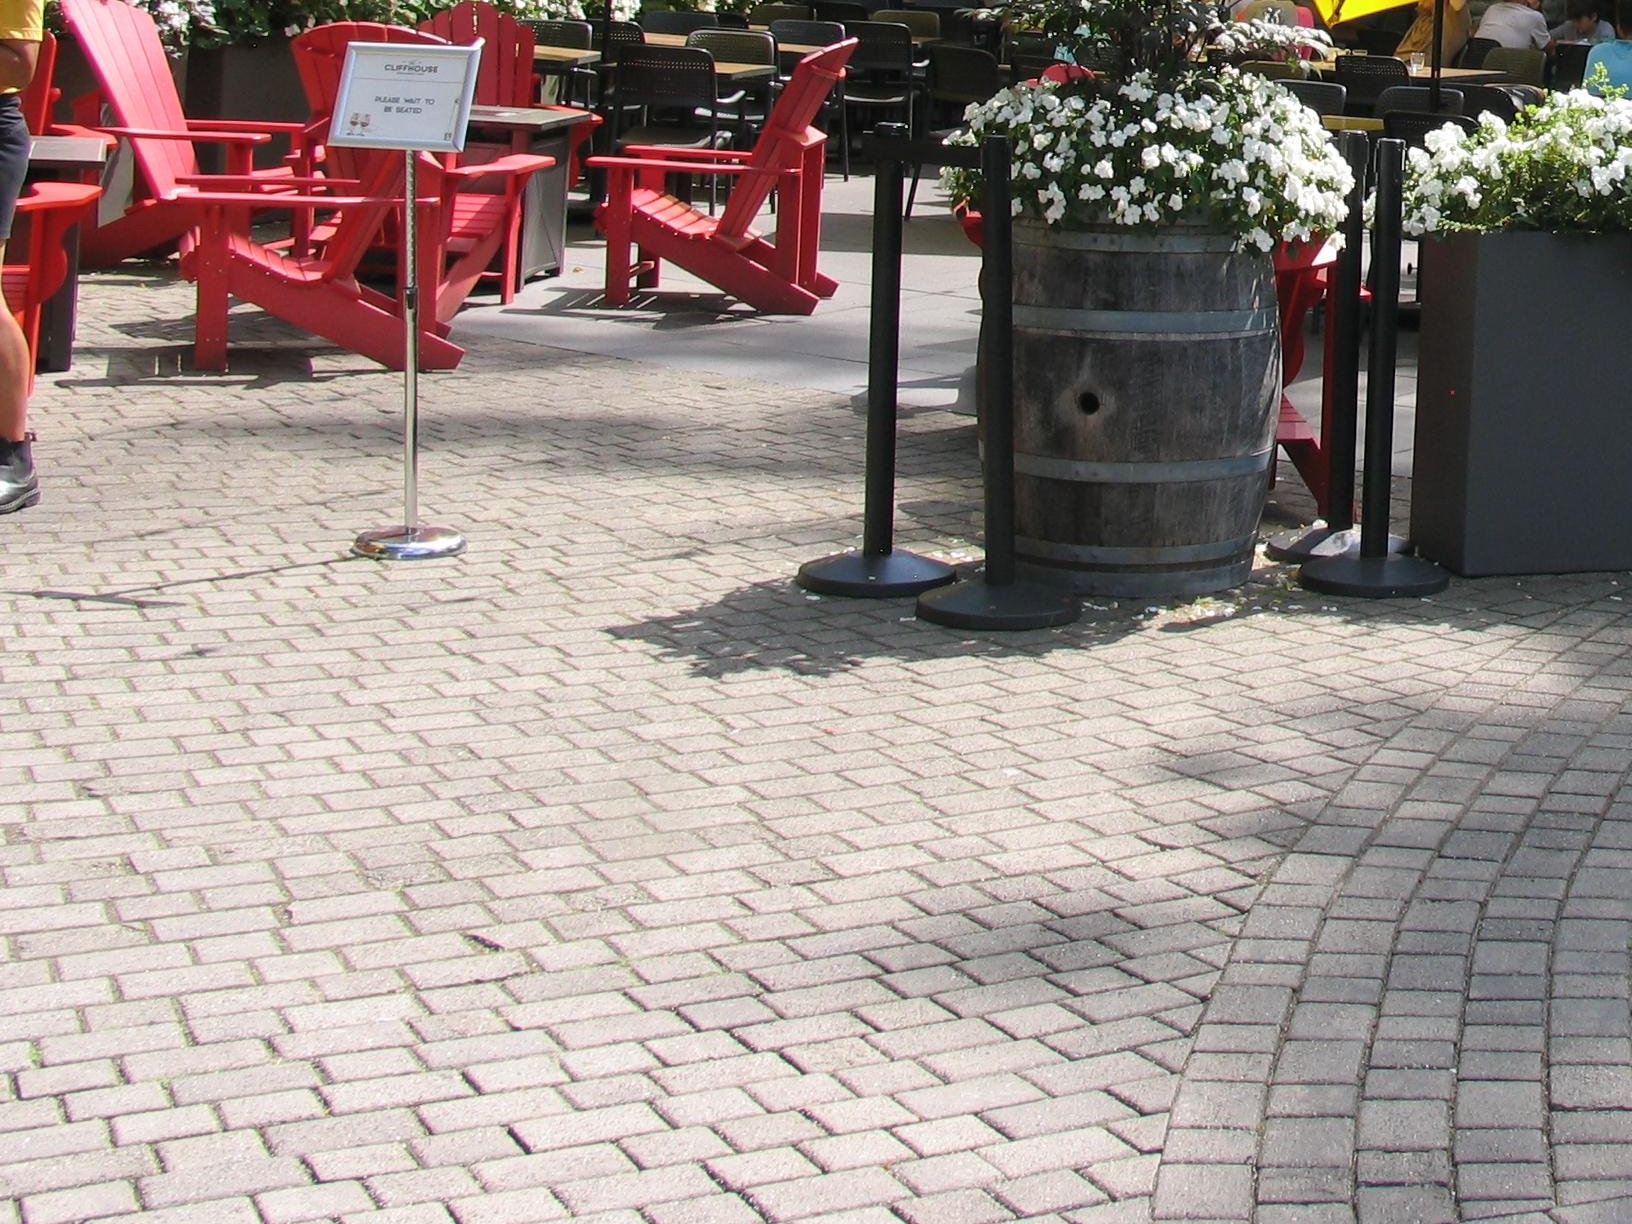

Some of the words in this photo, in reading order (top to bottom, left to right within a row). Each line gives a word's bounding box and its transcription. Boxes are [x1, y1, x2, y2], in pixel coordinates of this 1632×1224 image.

[384, 64, 438, 73] CLIFFHOUSE
[374, 96, 401, 104] PLEASE
[404, 97, 421, 105] WAIT
[396, 106, 422, 114] SEATED
